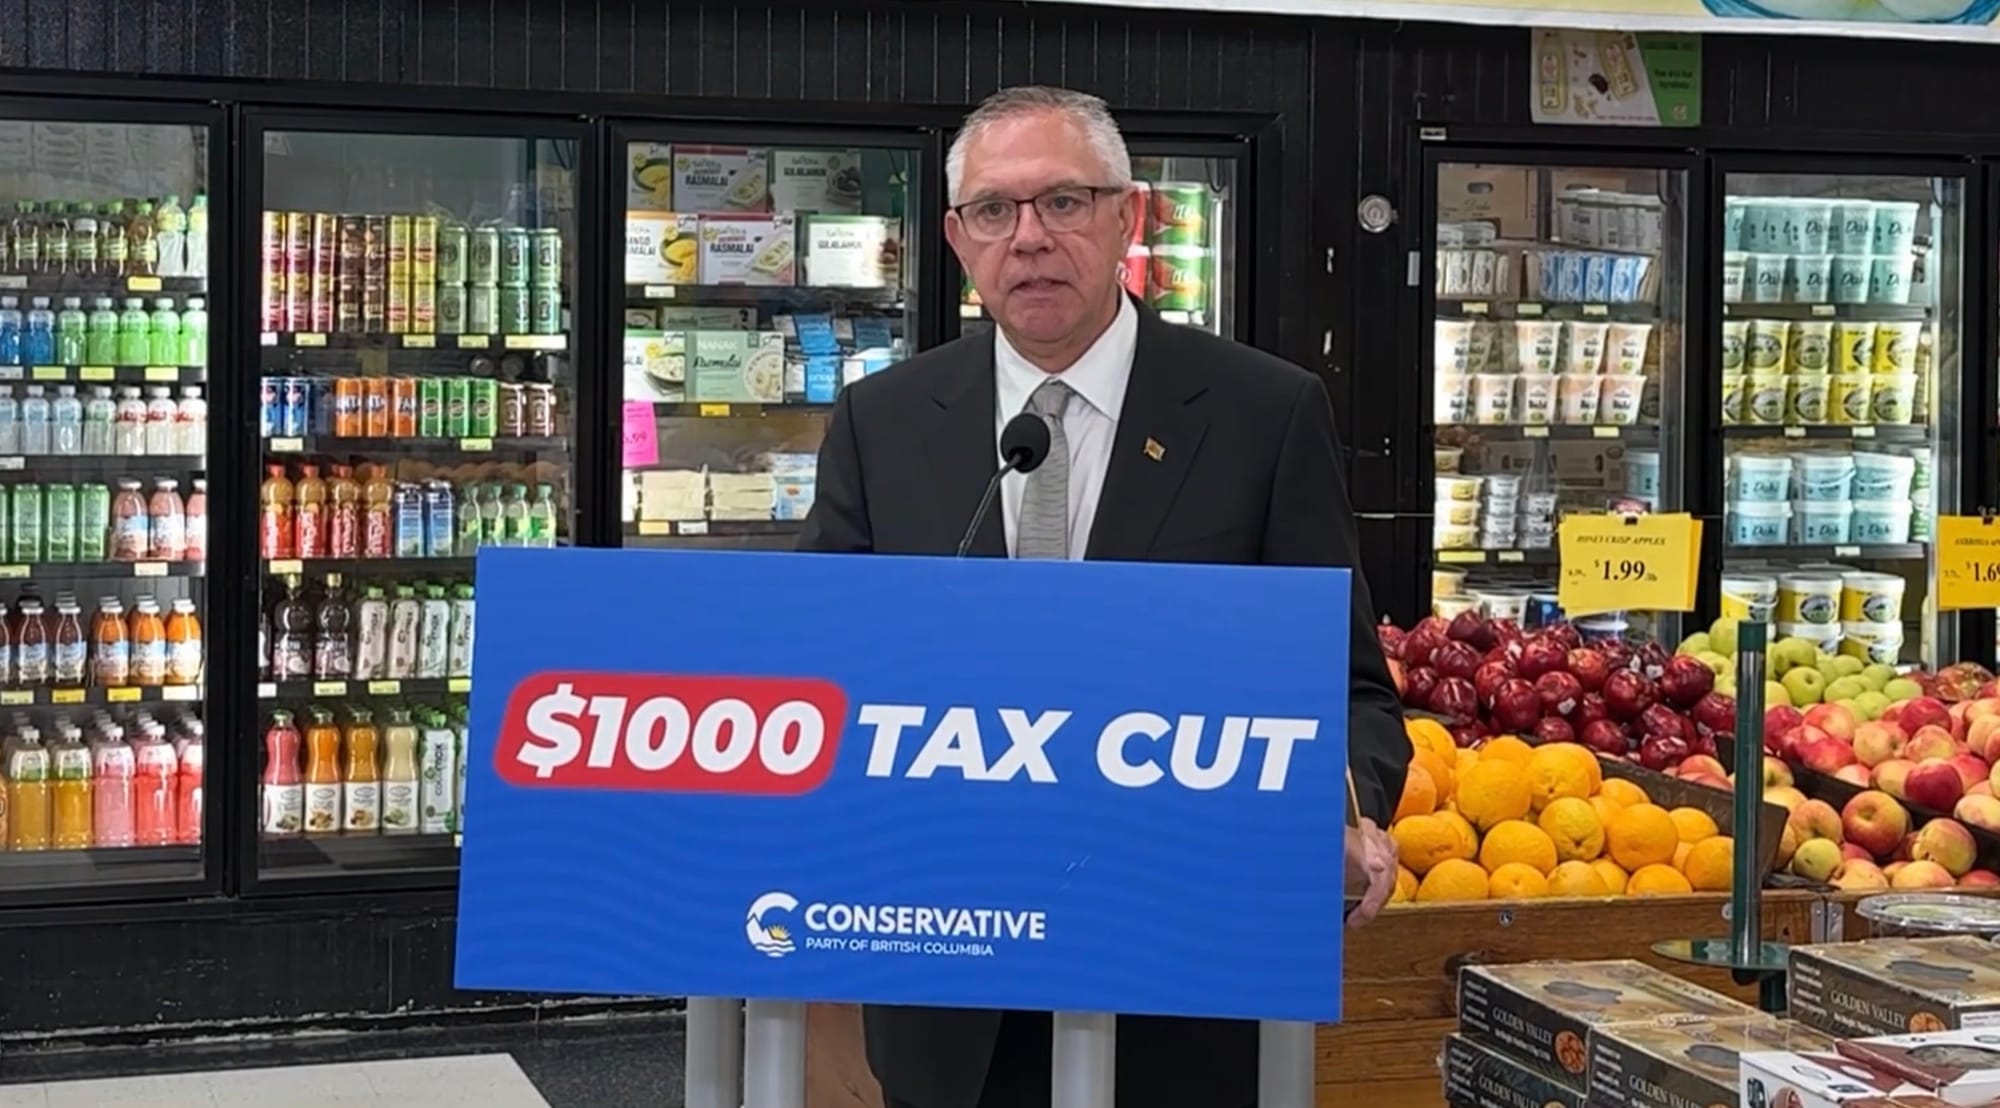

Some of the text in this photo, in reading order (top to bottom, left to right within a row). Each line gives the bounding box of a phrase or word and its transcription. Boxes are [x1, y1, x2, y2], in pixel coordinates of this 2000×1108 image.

[516, 684, 1319, 792] $1000 TAX CUT
[804, 903, 1046, 940] CONSERVATIVE
[806, 937, 994, 957] PARTY OF BRITISH COLUMBIA
[1492, 1006, 1525, 1032] GOLDEN
[1525, 1021, 1553, 1046] VALLEY
[1829, 989, 1871, 1017] GOLDEN
[1871, 1003, 1906, 1030] VALLEY
[1478, 1074, 1512, 1101] GOLDEN
[1628, 1074, 1668, 1103] GOLDEN
